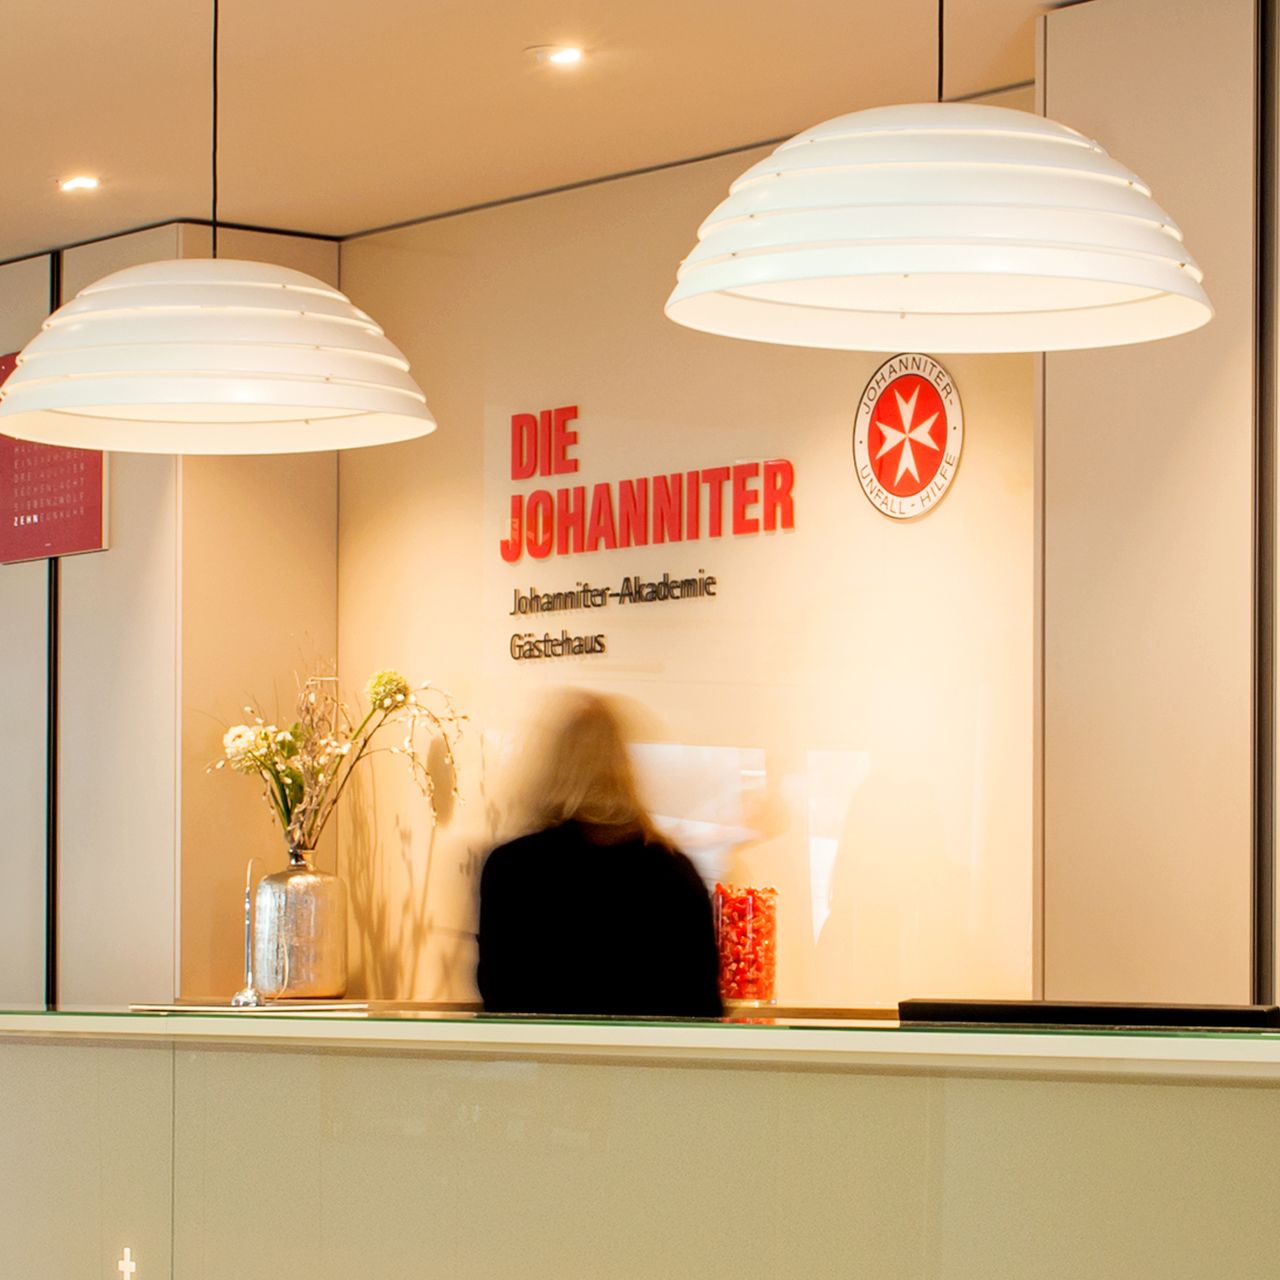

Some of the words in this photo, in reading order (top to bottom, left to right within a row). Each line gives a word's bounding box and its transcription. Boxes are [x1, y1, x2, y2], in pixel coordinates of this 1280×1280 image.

[510, 405, 579, 481] DIE
[500, 458, 796, 564] JOHANNITER
[509, 568, 717, 618] Johanniter-Akademie
[509, 629, 607, 662] Gästehaus
